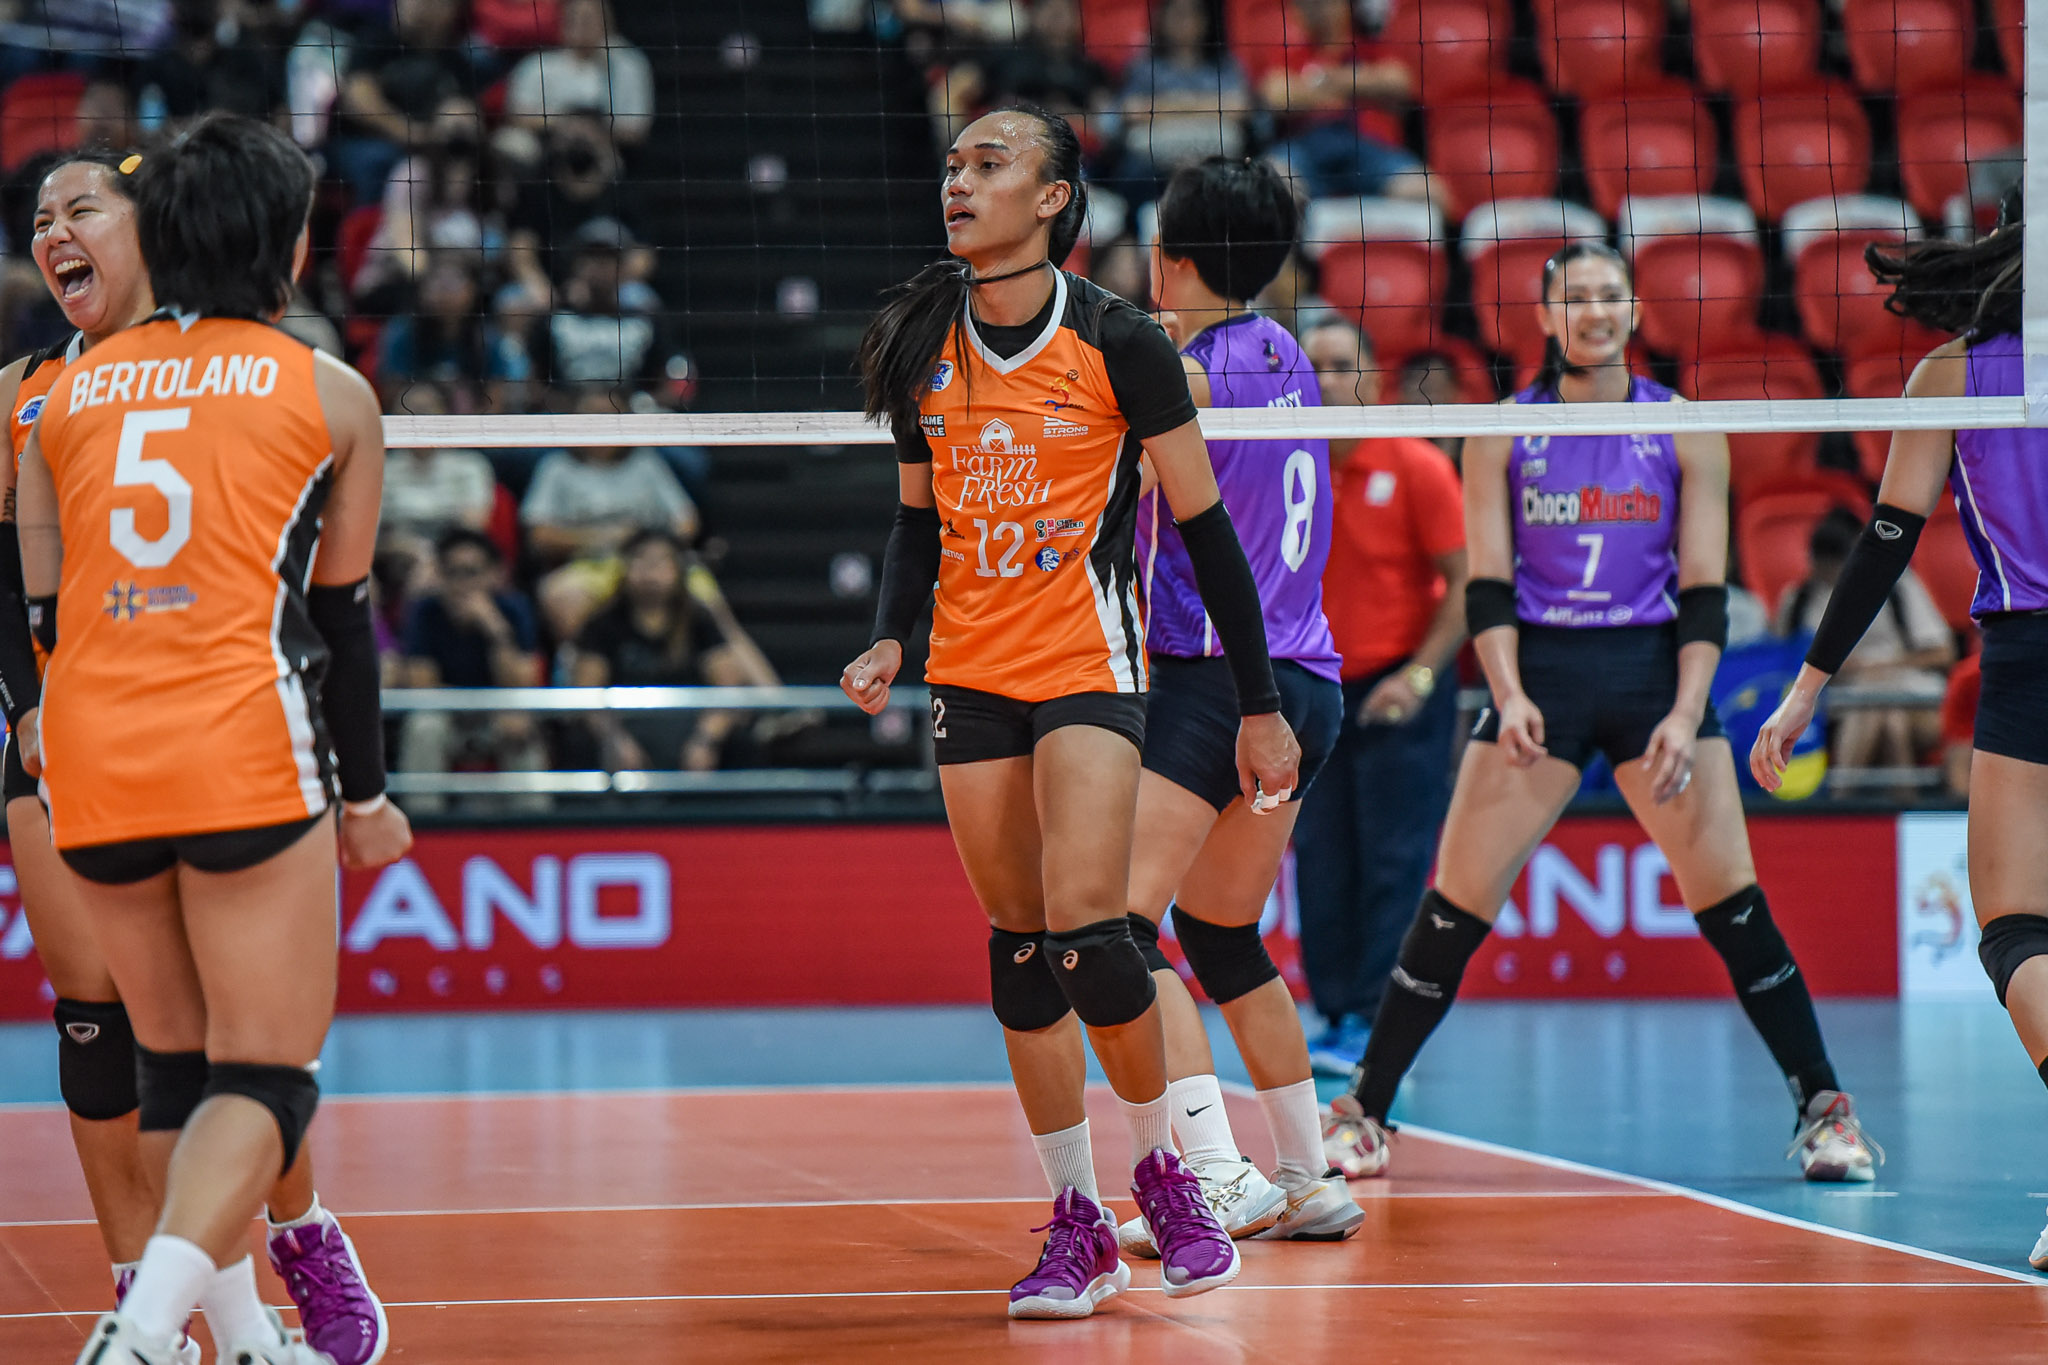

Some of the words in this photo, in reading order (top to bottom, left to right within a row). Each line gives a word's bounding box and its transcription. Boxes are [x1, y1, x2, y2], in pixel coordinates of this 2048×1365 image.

[67, 354, 279, 416] BERTOLANO
[1043, 425, 1088, 434] STRONG
[109, 407, 193, 568] 5
[1281, 449, 1317, 573] 8
[973, 518, 1024, 577] 12
[1577, 533, 1604, 588] 7
[932, 697, 946, 738] 2
[337, 852, 671, 953] ANO
